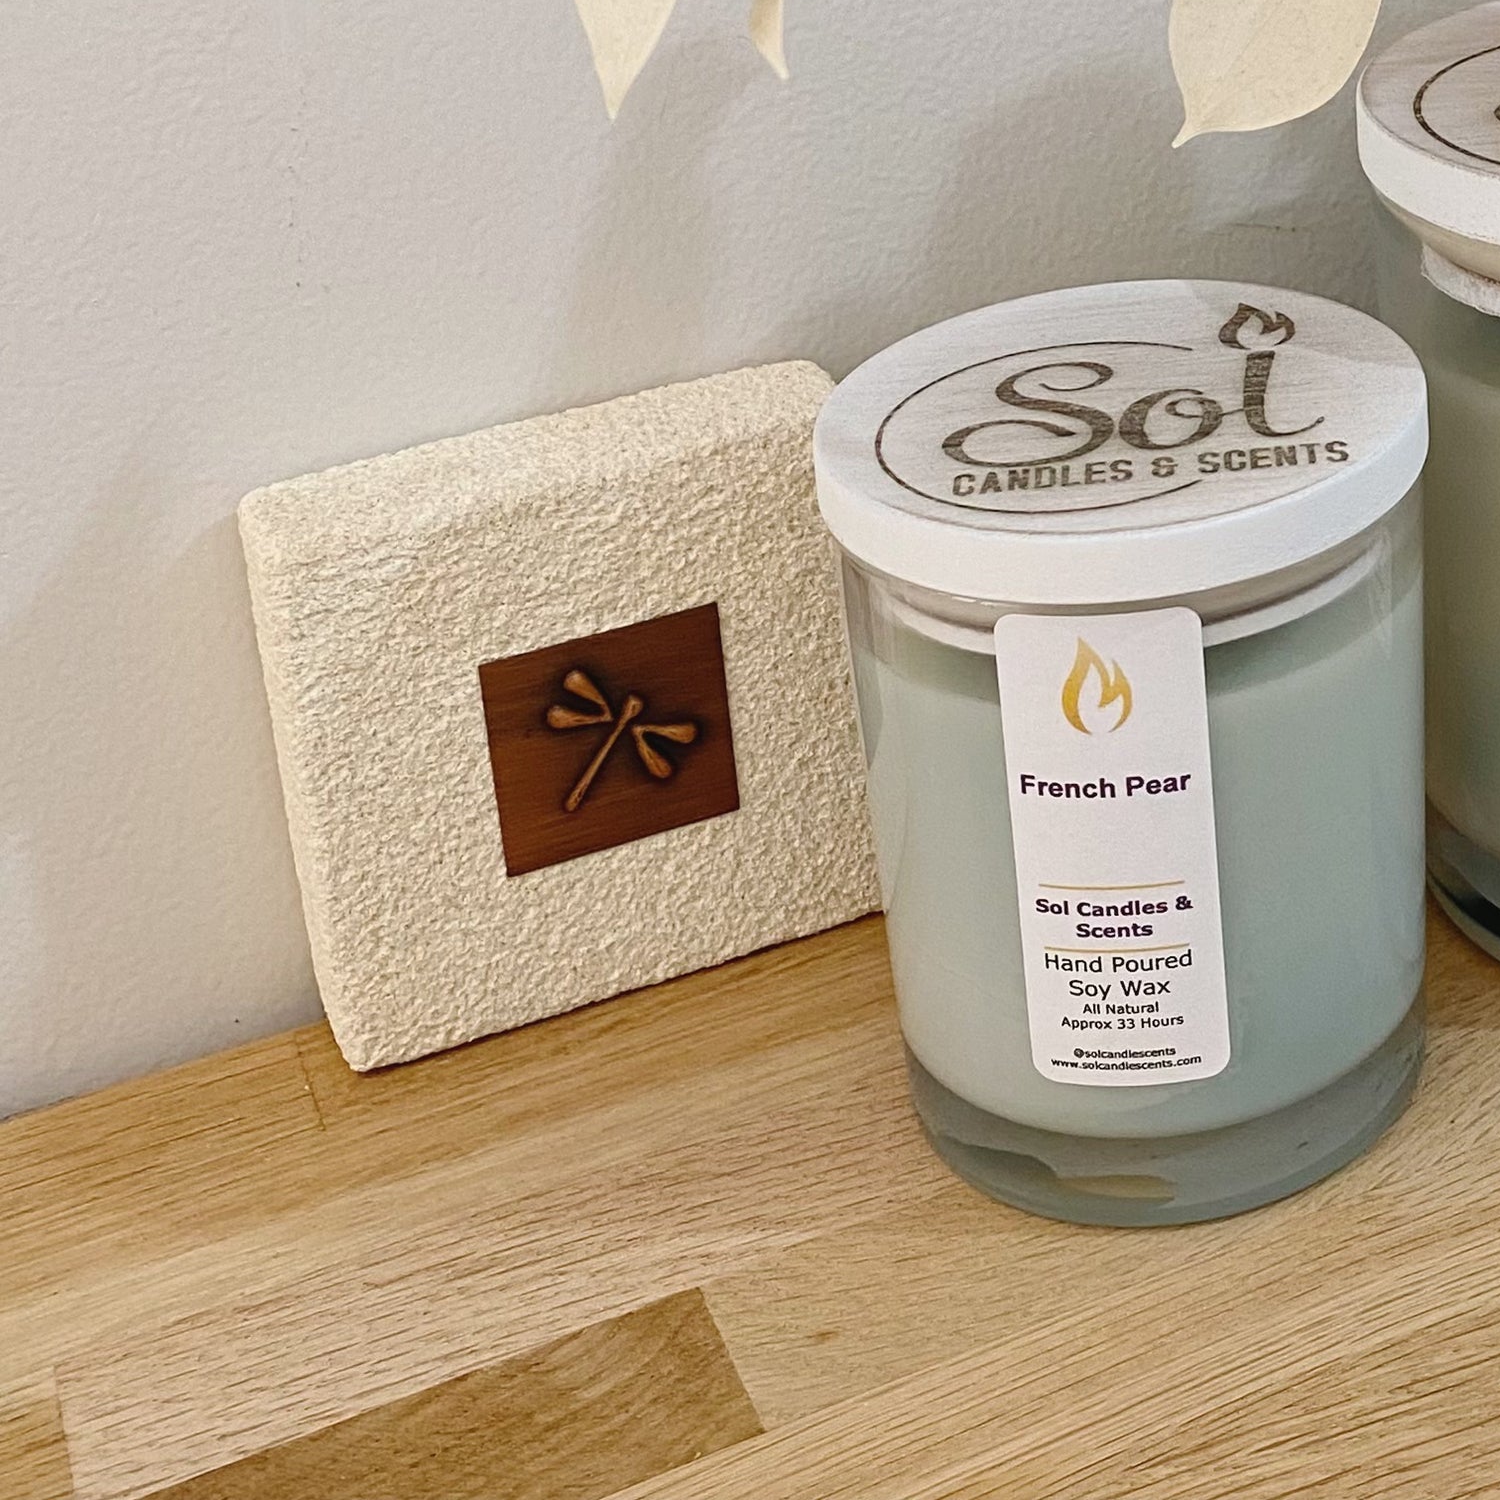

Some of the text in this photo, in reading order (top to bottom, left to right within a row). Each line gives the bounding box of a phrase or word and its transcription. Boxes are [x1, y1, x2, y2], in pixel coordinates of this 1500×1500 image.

[941, 350, 1325, 467] Sol
[952, 440, 1350, 497] CANDLES & SCENTS
[1020, 774, 1191, 798] French Pear
[1035, 895, 1193, 917] Sol Candles &
[1076, 923, 1153, 938] Scents
[1044, 949, 1192, 973] Hand Poured
[1069, 980, 1171, 1000] Soy Wax
[1083, 1001, 1159, 1015] All Natural
[1061, 1015, 1184, 1030] Approx 33 Hours
[1051, 1055, 1201, 1070] www.solcandlescents.com
[1073, 1047, 1176, 1059] @solcandlescents
